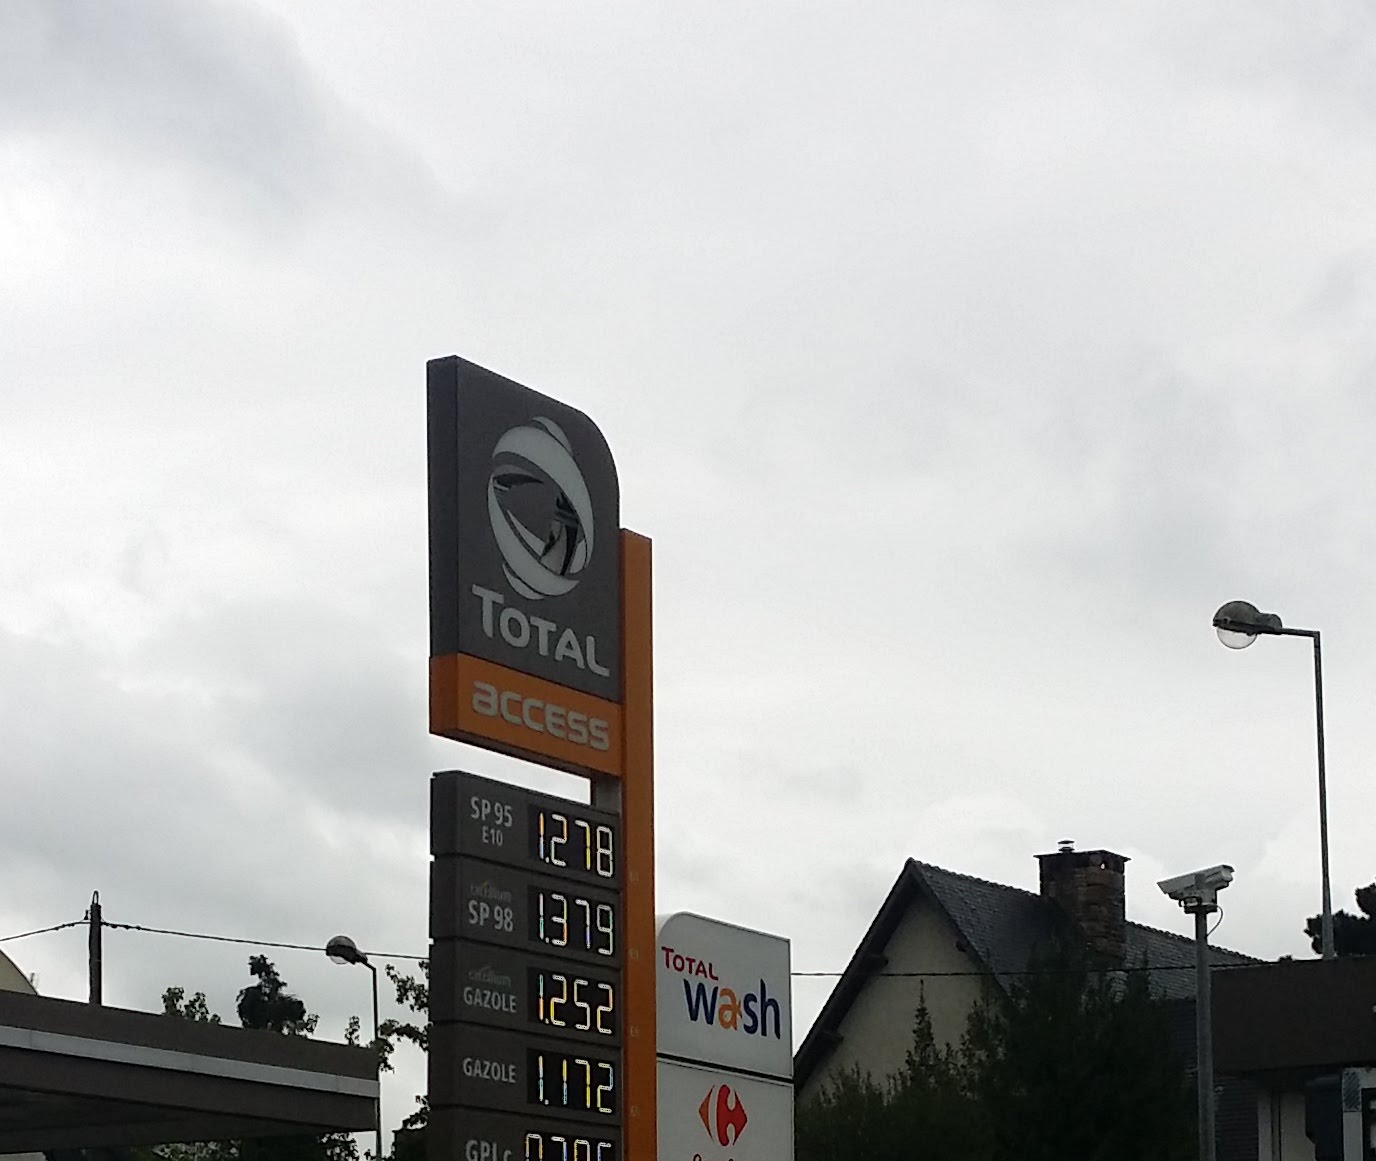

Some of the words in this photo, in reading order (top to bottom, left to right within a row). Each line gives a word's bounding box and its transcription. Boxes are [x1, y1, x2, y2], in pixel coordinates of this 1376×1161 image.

[471, 583, 611, 678] TOTAL
[470, 796, 491, 821] SP
[494, 802, 513, 827] 95
[482, 825, 503, 847] E10
[539, 811, 614, 878] 1.278
[468, 899, 490, 926] SP
[493, 905, 514, 932] 98
[538, 892, 614, 956] 1.379
[661, 946, 719, 981] TOTAL
[463, 986, 518, 1014] GAZOLE
[538, 972, 614, 1035] 1.252
[683, 978, 781, 1040] wash
[462, 1056, 517, 1084] GAZOLE
[538, 1054, 614, 1114] 1.172
